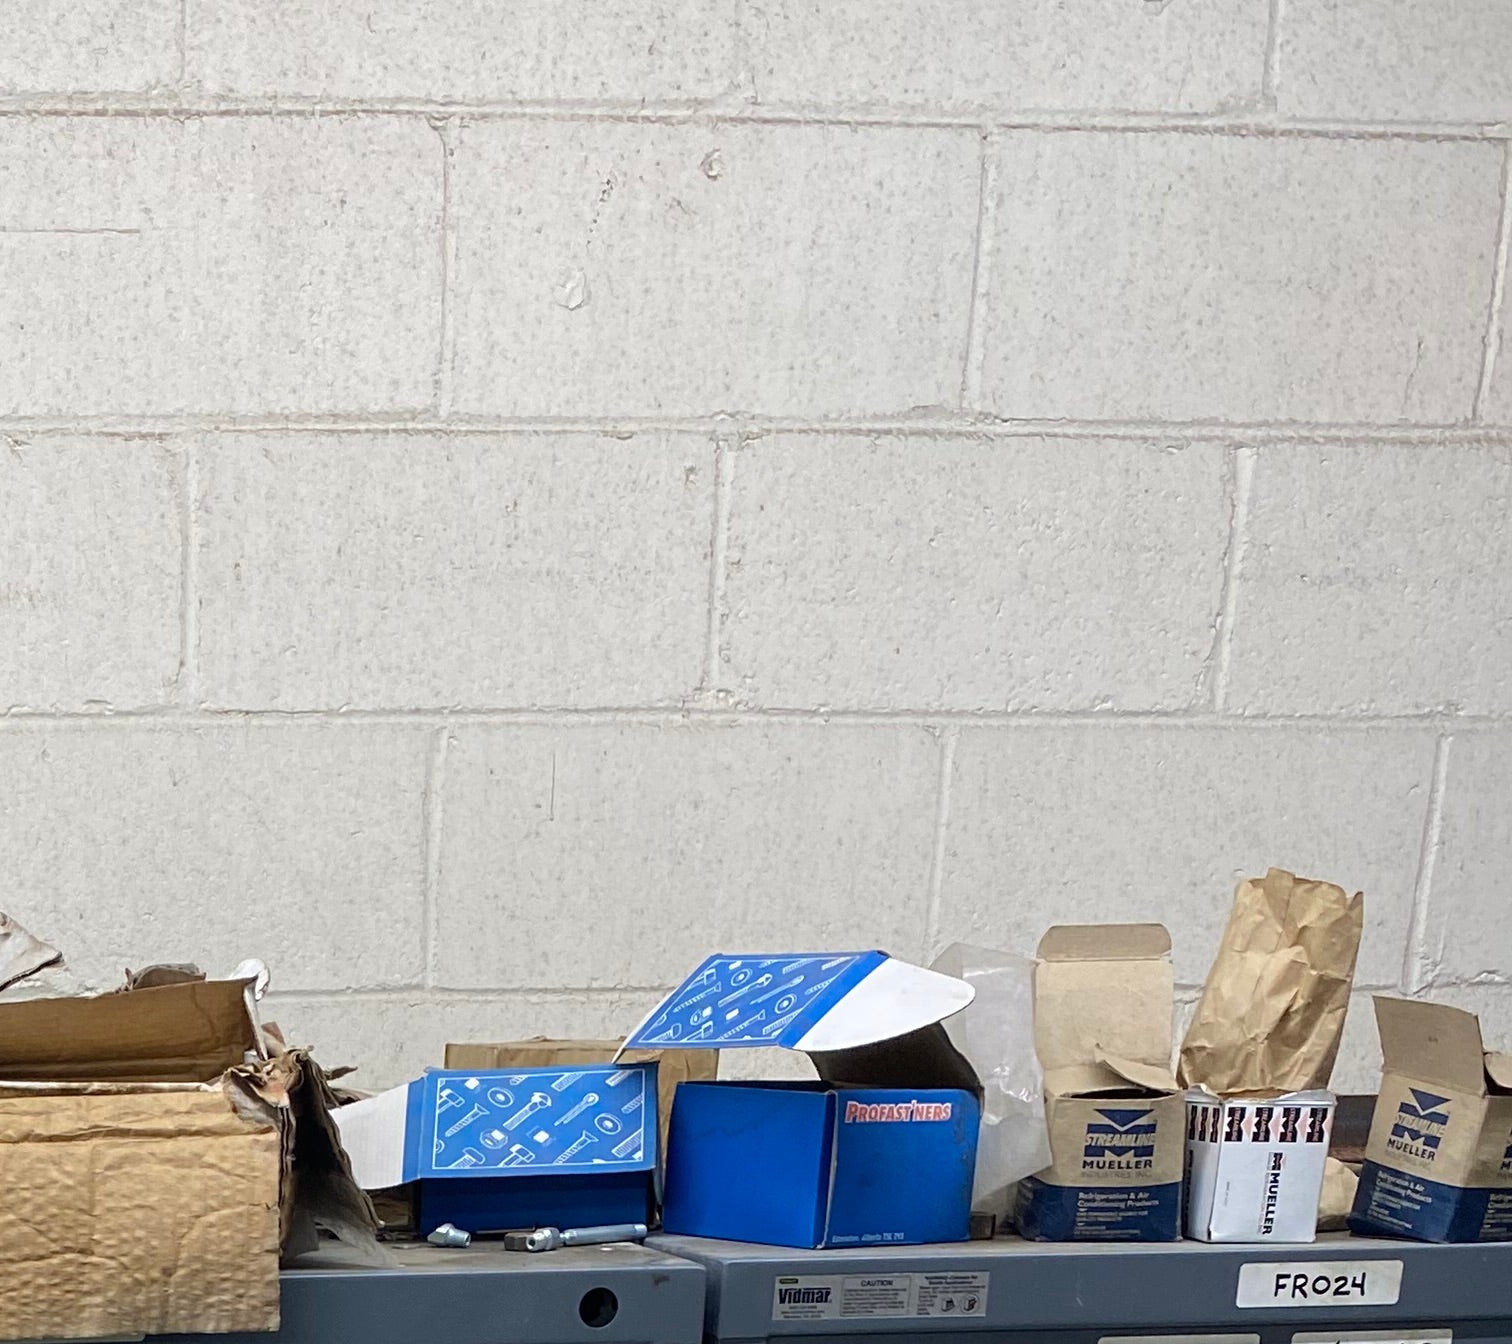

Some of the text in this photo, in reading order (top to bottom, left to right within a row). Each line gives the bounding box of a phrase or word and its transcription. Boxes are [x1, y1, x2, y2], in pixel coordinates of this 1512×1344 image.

[1086, 1133, 1156, 1147] STREAMLINE
[1386, 1138, 1436, 1161] MUELLER
[1082, 1159, 1153, 1169] MUELLER
[1262, 1172, 1281, 1235] MUELLER
[860, 1279, 894, 1287] CAUTION
[778, 1287, 832, 1304] Vidmar
